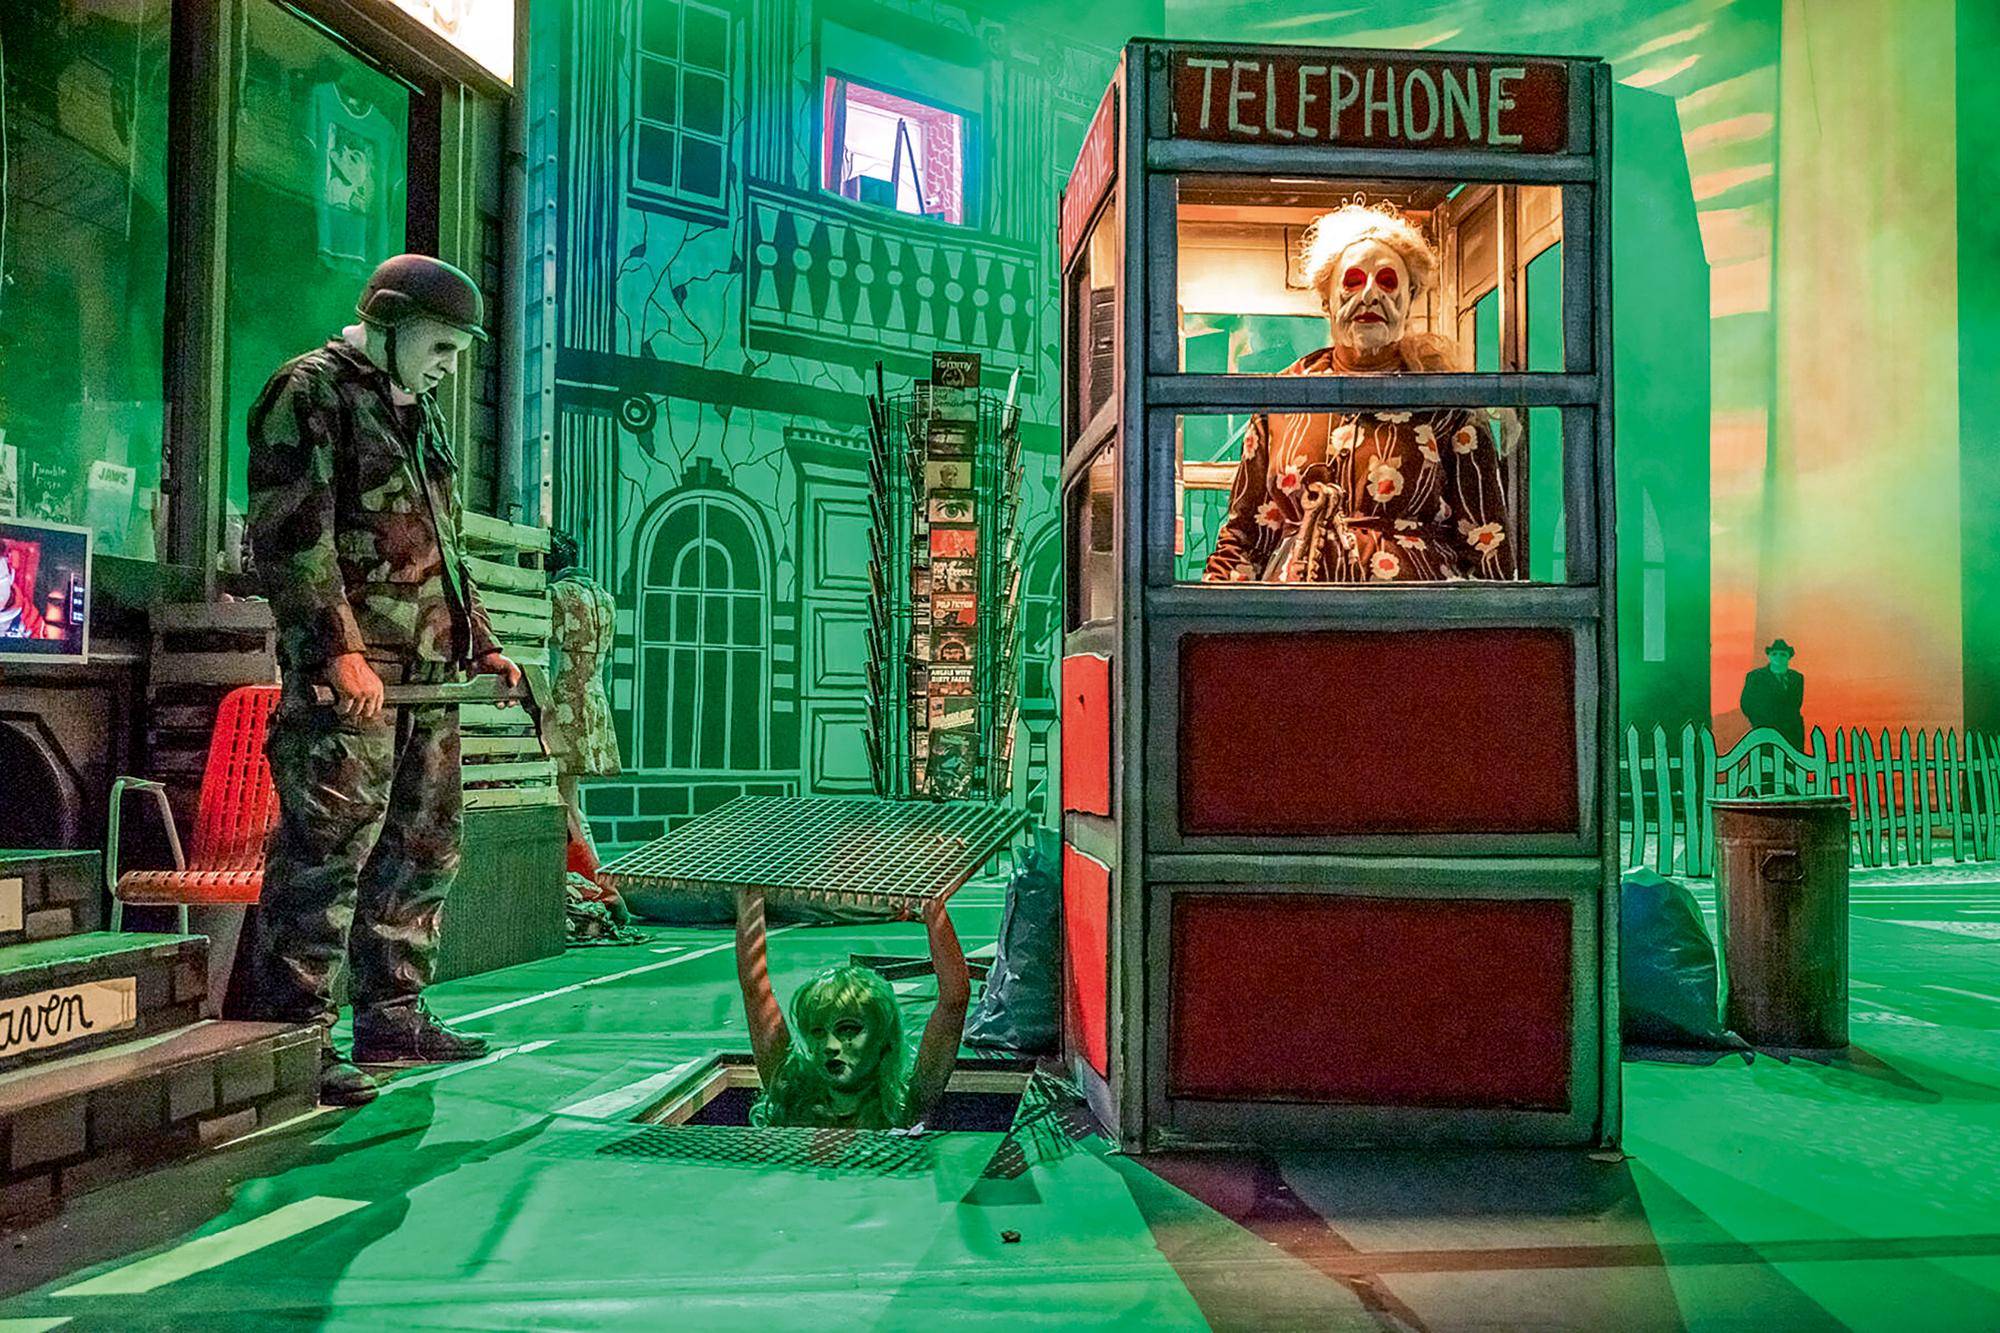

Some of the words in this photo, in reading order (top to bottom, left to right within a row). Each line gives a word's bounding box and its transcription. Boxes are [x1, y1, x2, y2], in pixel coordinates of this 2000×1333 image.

[1187, 58, 1526, 145] TELEPHONE
[934, 357, 972, 372] Tommy
[98, 467, 128, 486] JAWS
